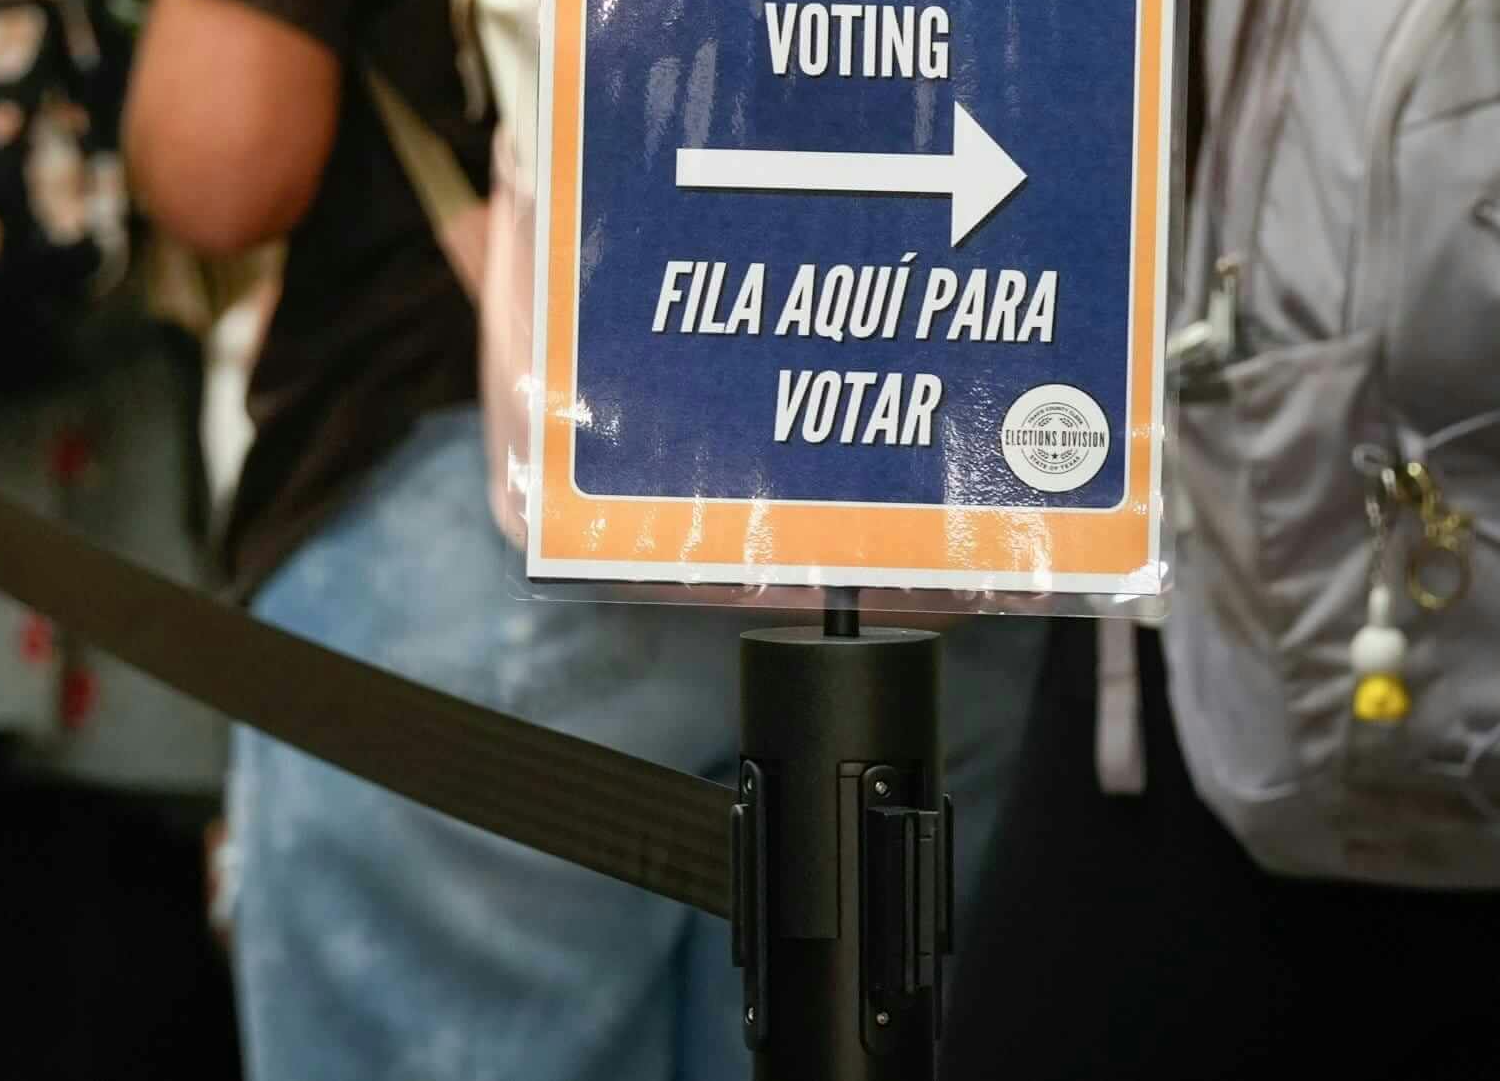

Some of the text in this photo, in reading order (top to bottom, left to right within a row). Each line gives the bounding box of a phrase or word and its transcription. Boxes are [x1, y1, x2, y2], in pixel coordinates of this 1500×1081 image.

[764, 2, 949, 79] VOTING
[651, 252, 1057, 342] FILA AQUÍ PARA
[773, 369, 943, 446] VOTAR
[1005, 429, 1105, 448] ELECTIONS DIVISION
[1030, 454, 1047, 469] STATE
[1061, 456, 1081, 470] TEXAS
